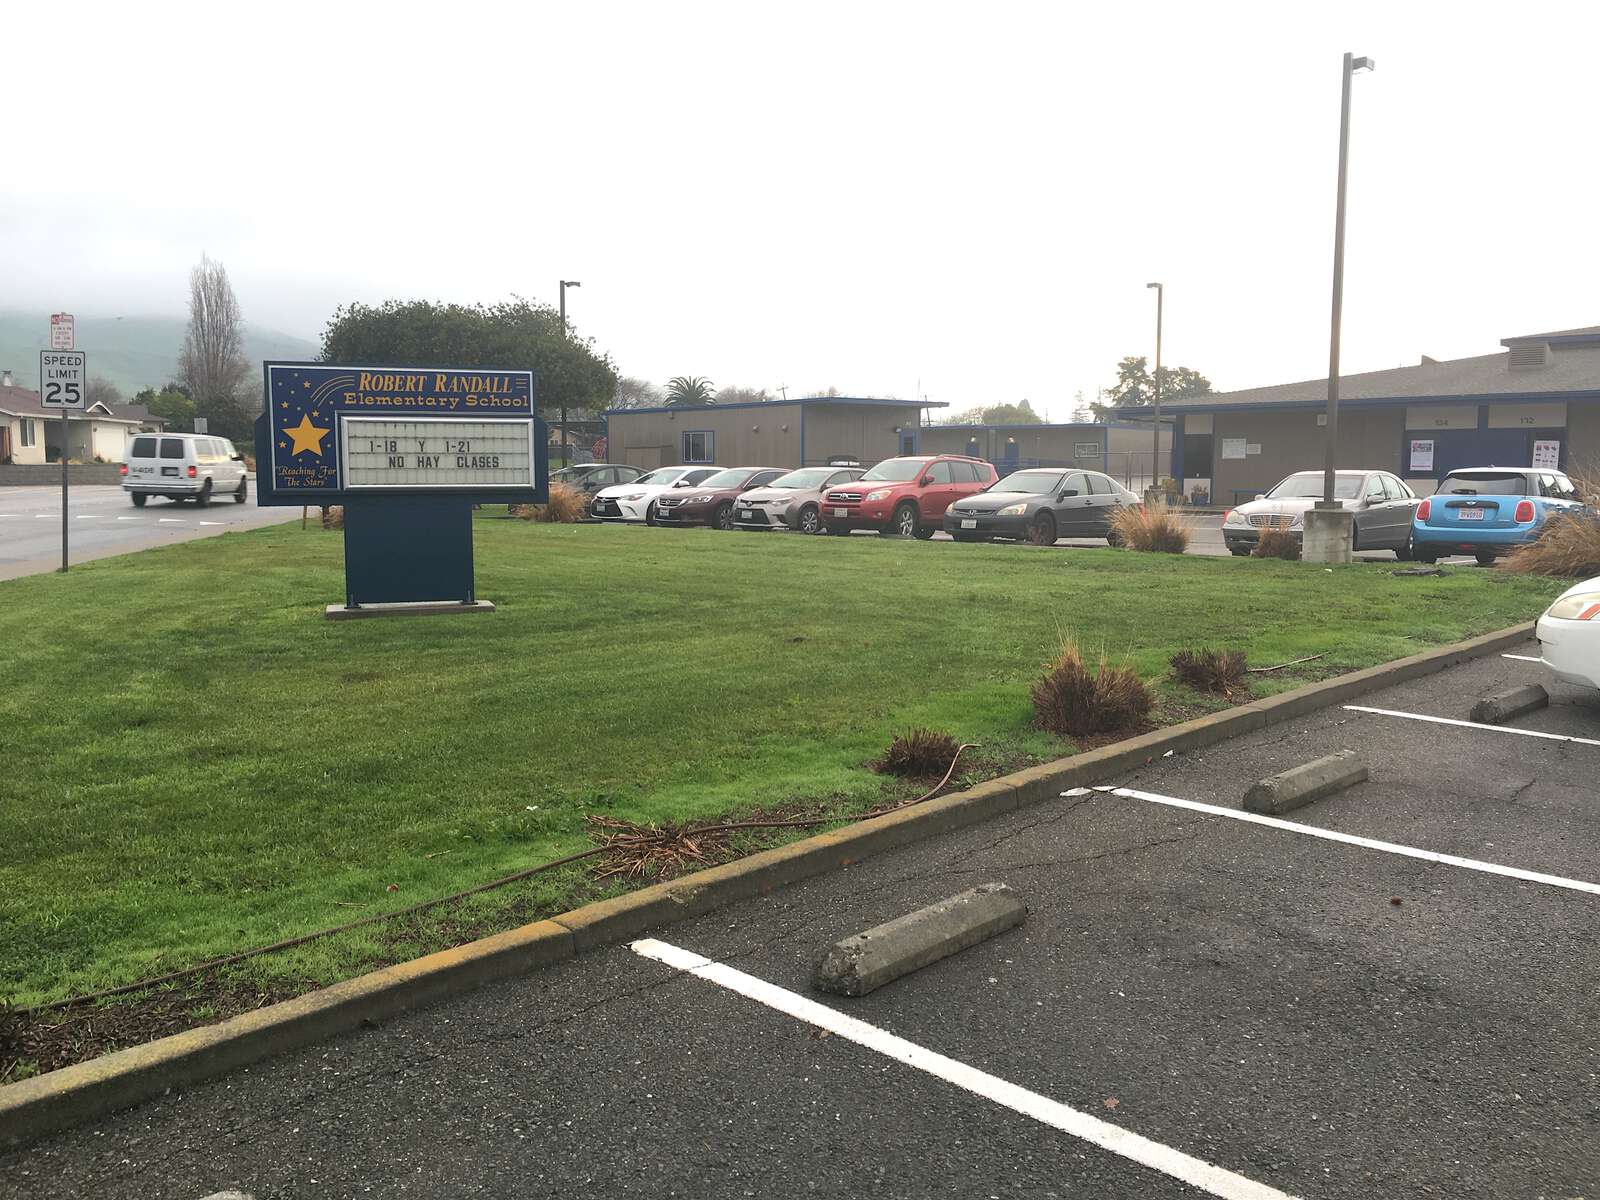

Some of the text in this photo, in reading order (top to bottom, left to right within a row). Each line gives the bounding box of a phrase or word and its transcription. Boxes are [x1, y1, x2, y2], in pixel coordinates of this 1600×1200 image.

[44, 356, 82, 366] SPEED
[48, 369, 79, 379] LIMIT
[359, 372, 513, 393] ROBERT RANDALL
[45, 382, 81, 404] 25
[344, 392, 528, 409] Elementary School
[370, 440, 470, 453] 1-18 Y 1-21
[388, 456, 500, 468] NO HAY CLASES
[318, 465, 337, 478] For
[285, 476, 300, 487] The
